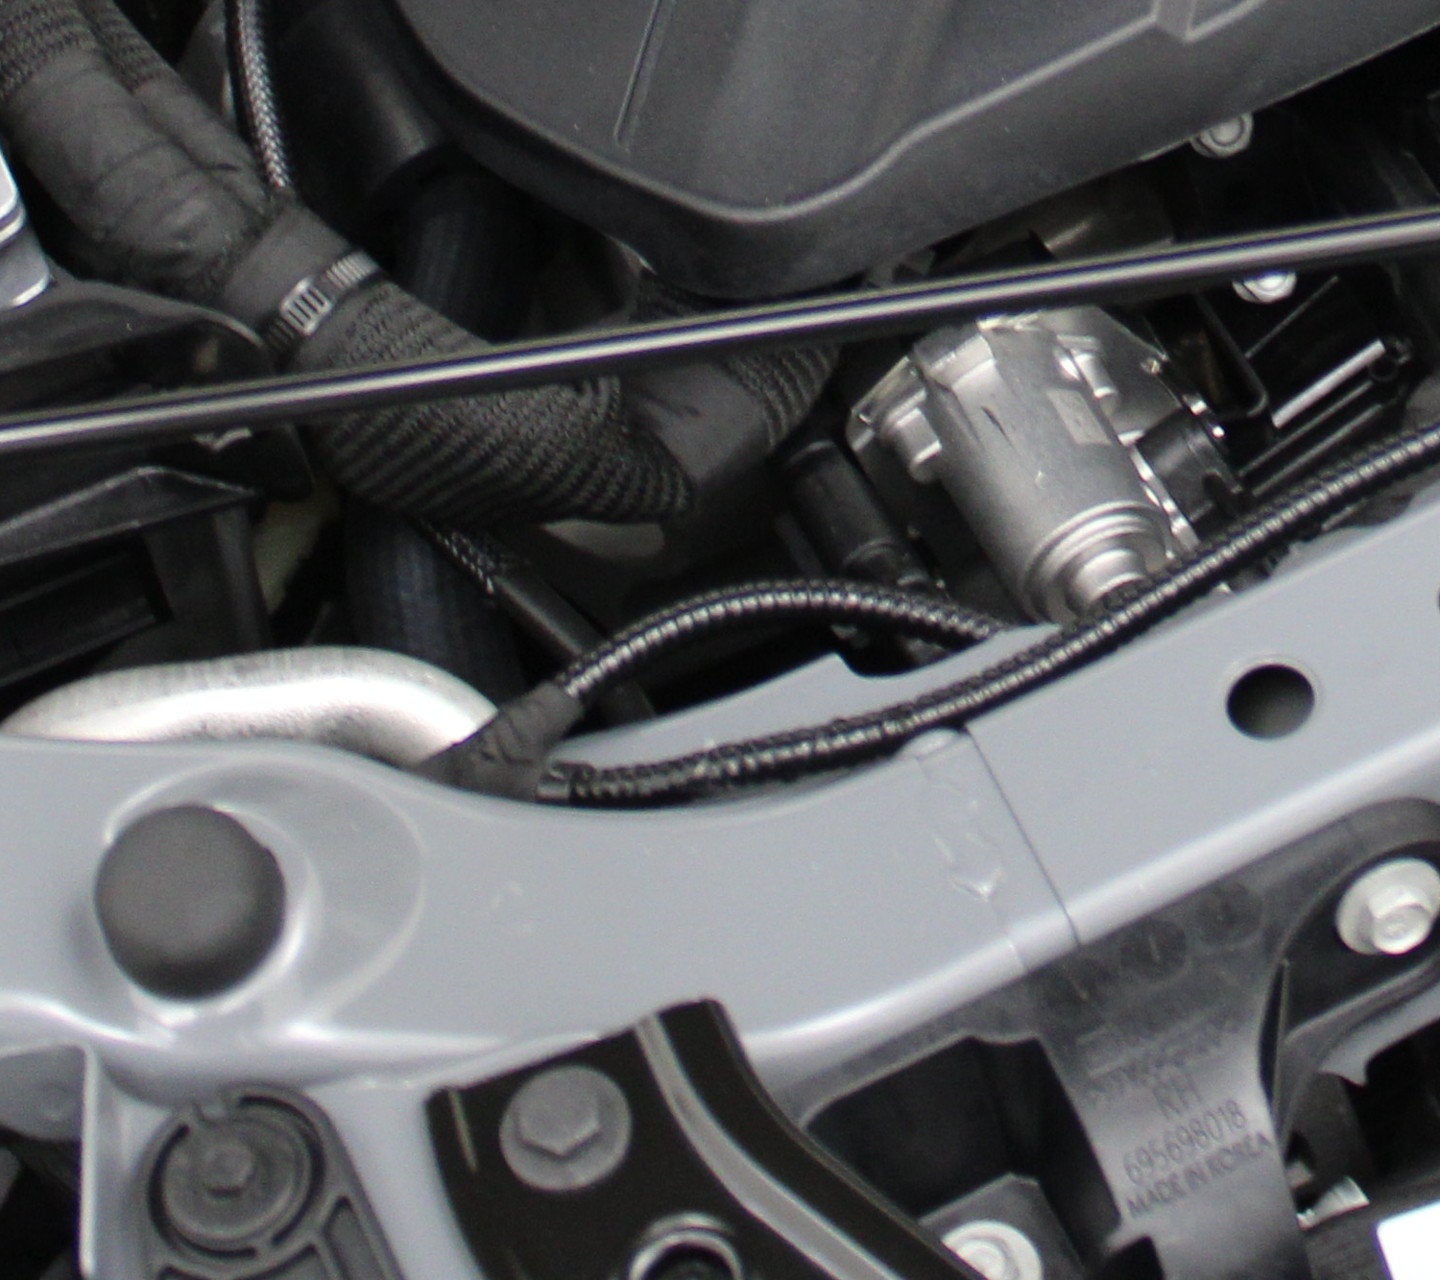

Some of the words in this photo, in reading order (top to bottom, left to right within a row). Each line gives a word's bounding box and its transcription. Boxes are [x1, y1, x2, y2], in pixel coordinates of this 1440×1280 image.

[1126, 1172, 1187, 1219] MADE
[1182, 1160, 1211, 1191] IN
[1205, 1131, 1272, 1178] KOREA
